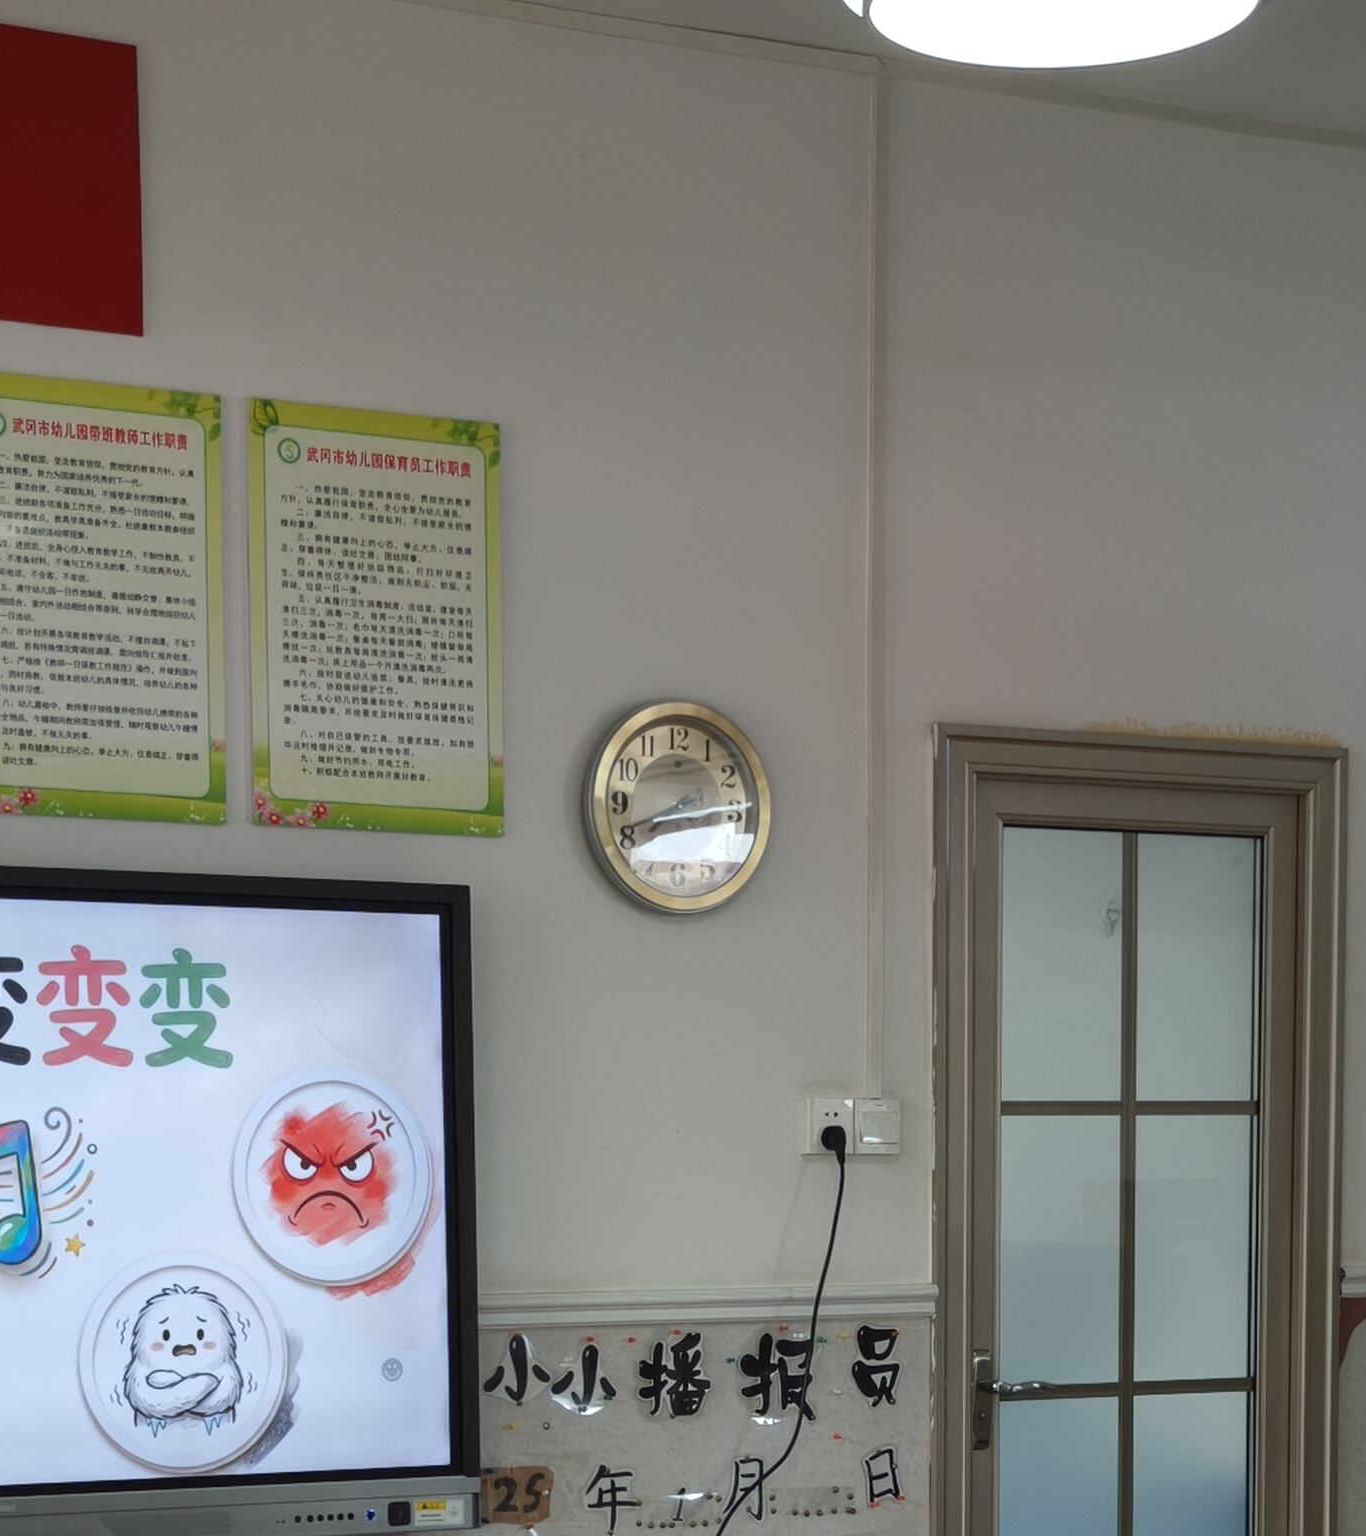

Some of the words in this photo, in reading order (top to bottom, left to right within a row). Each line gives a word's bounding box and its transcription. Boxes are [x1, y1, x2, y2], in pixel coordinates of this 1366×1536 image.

[12, 417, 186, 450] 武冈市幼儿园带班教师工作职责
[307, 446, 470, 476] 武冈市幼儿园保育员工作职责
[640, 735, 655, 757] 11
[668, 727, 690, 752] 12
[704, 738, 711, 763] 1
[619, 758, 638, 782] 10
[720, 765, 736, 789] 2
[611, 791, 628, 815] 9
[619, 825, 636, 850] 8
[669, 863, 686, 887] 6
[482, 1324, 902, 1420] 小小播报员
[493, 1474, 544, 1514] 25
[585, 1464, 641, 1535] 年
[723, 1457, 765, 1521] 月
[866, 1448, 903, 1503] 日
